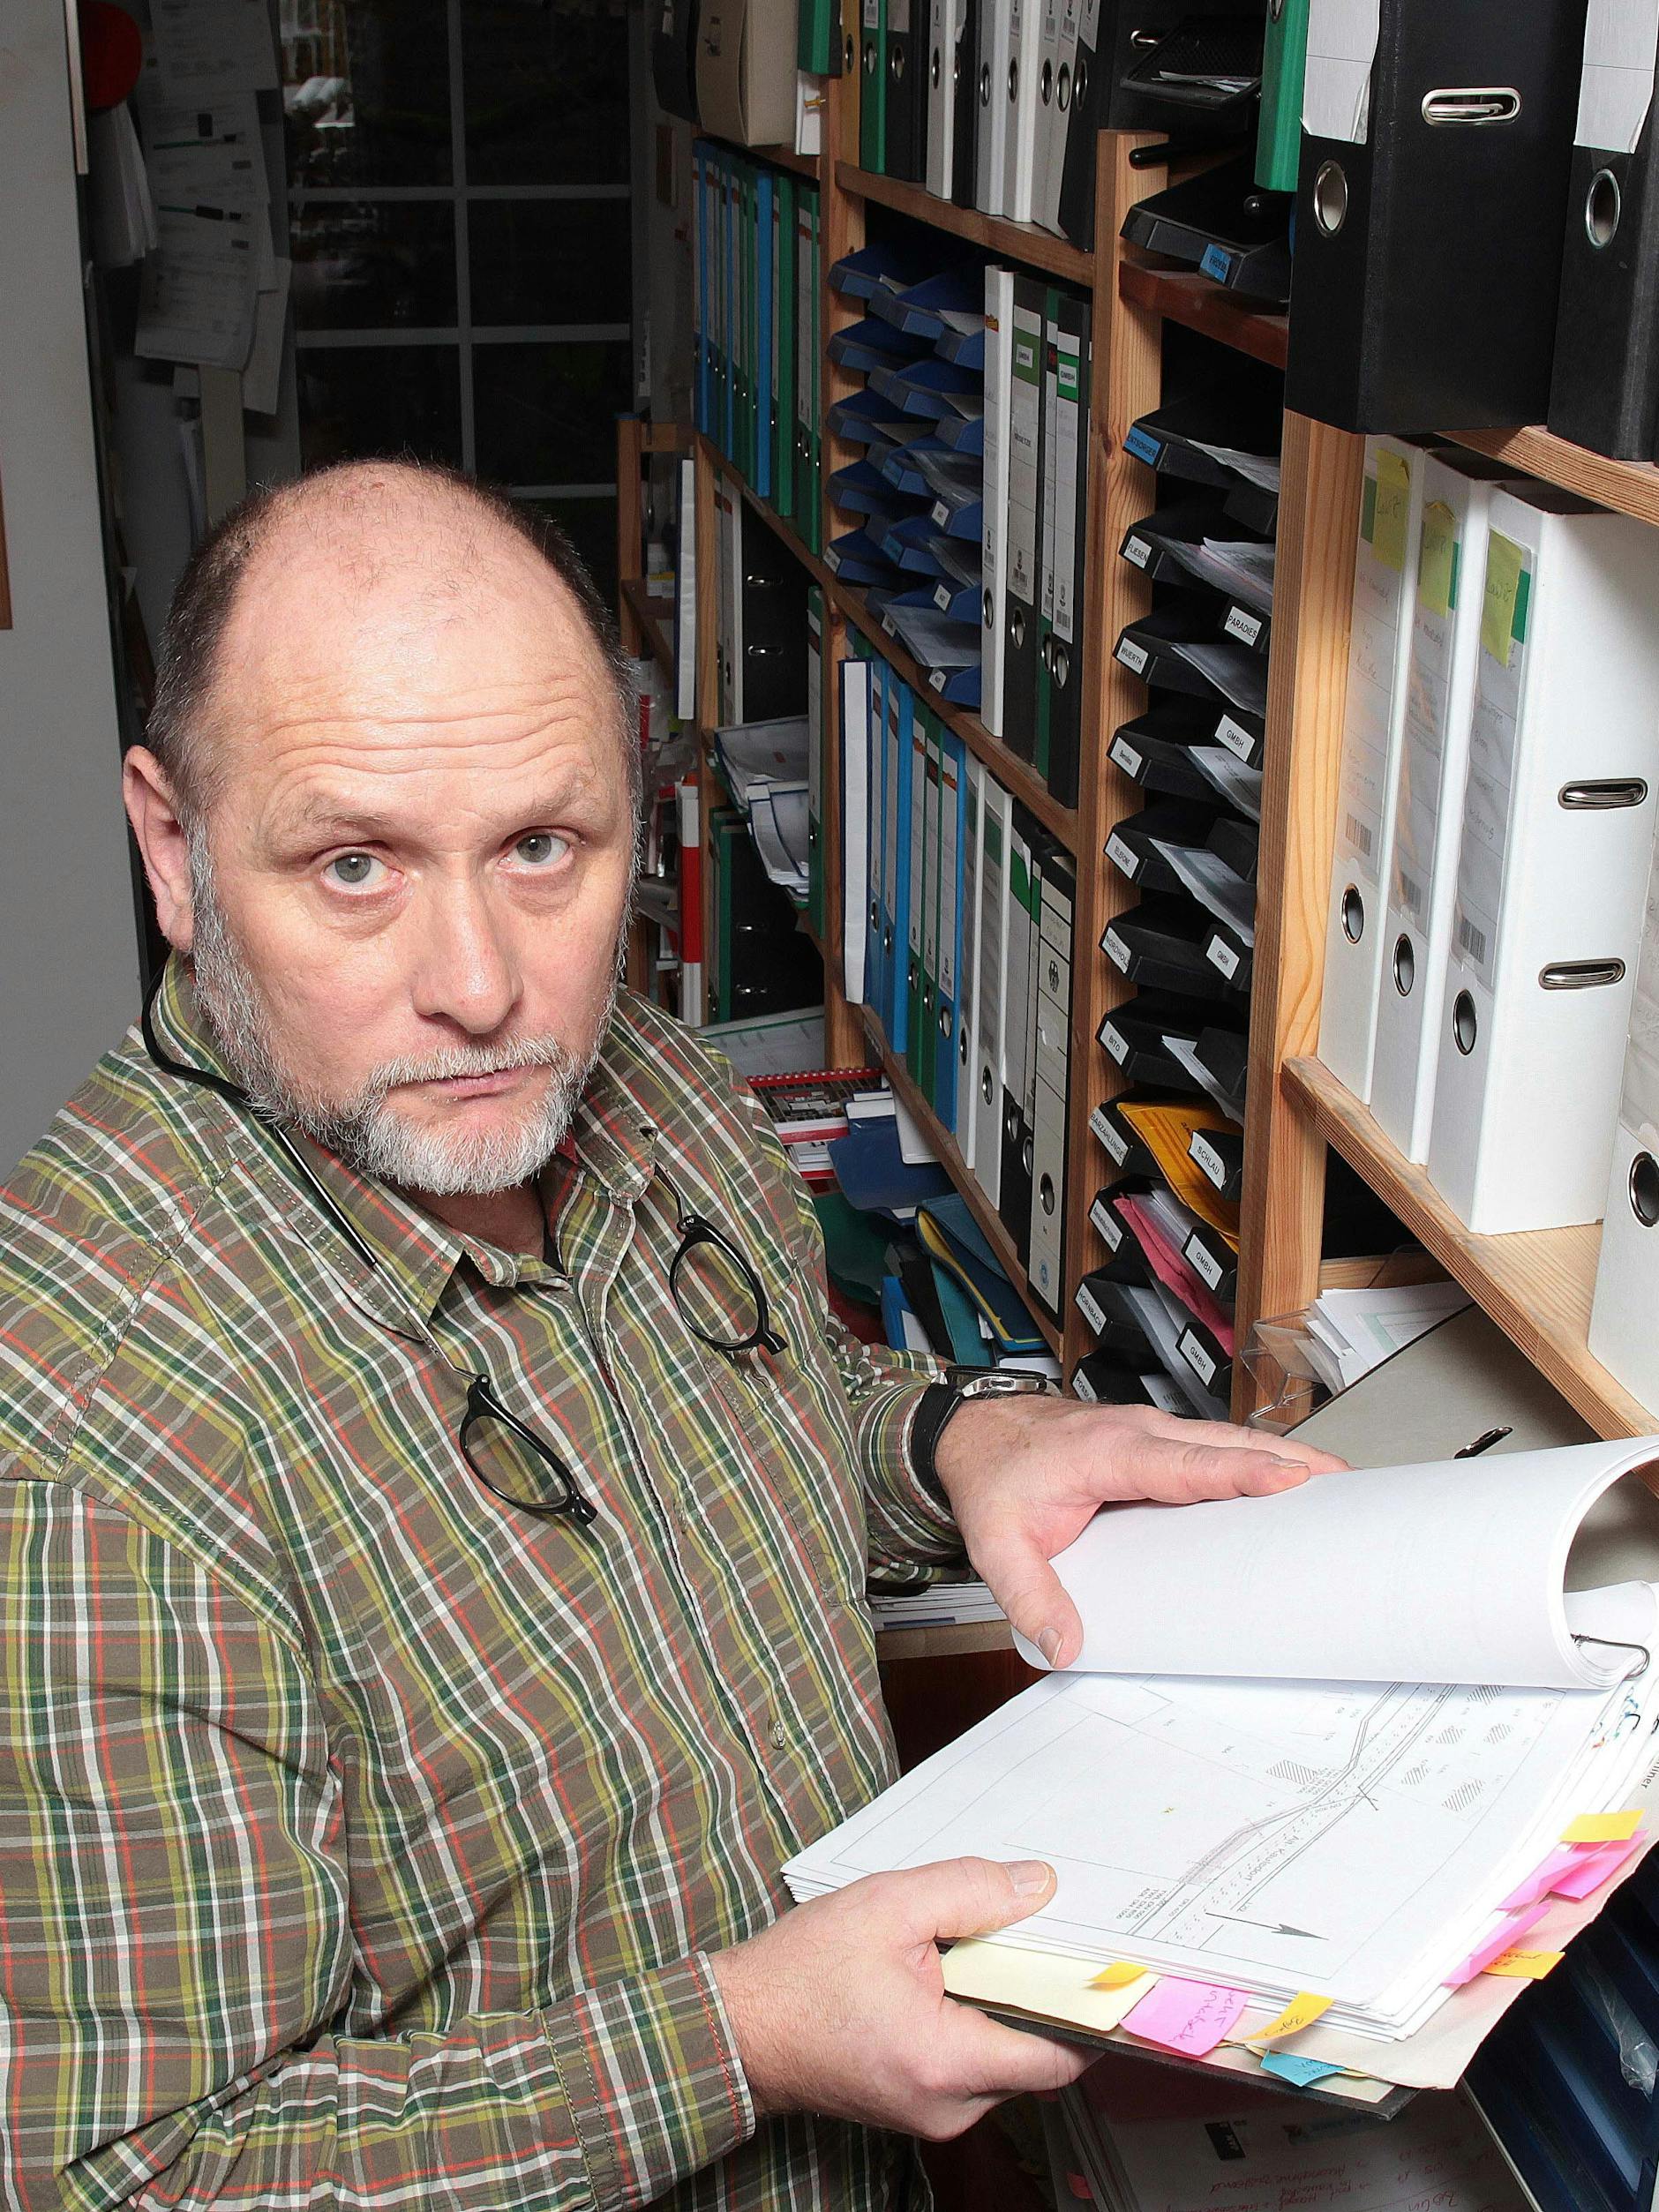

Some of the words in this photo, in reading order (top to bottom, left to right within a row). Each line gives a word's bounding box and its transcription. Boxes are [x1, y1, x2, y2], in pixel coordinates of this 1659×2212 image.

[1127, 544, 1148, 562] FLIESEN
[1228, 615, 1257, 639] PARADIES
[1121, 647, 1143, 667] WUERTH
[1227, 729, 1244, 749] GMBH
[1109, 1034, 1120, 1052] BITO
[1197, 1145, 1220, 1175] SCHLAU
[1197, 1251, 1212, 1275] GMBH
[1077, 1292, 1103, 1331] HORNBACH
[1190, 1346, 1206, 1370] GMBH
